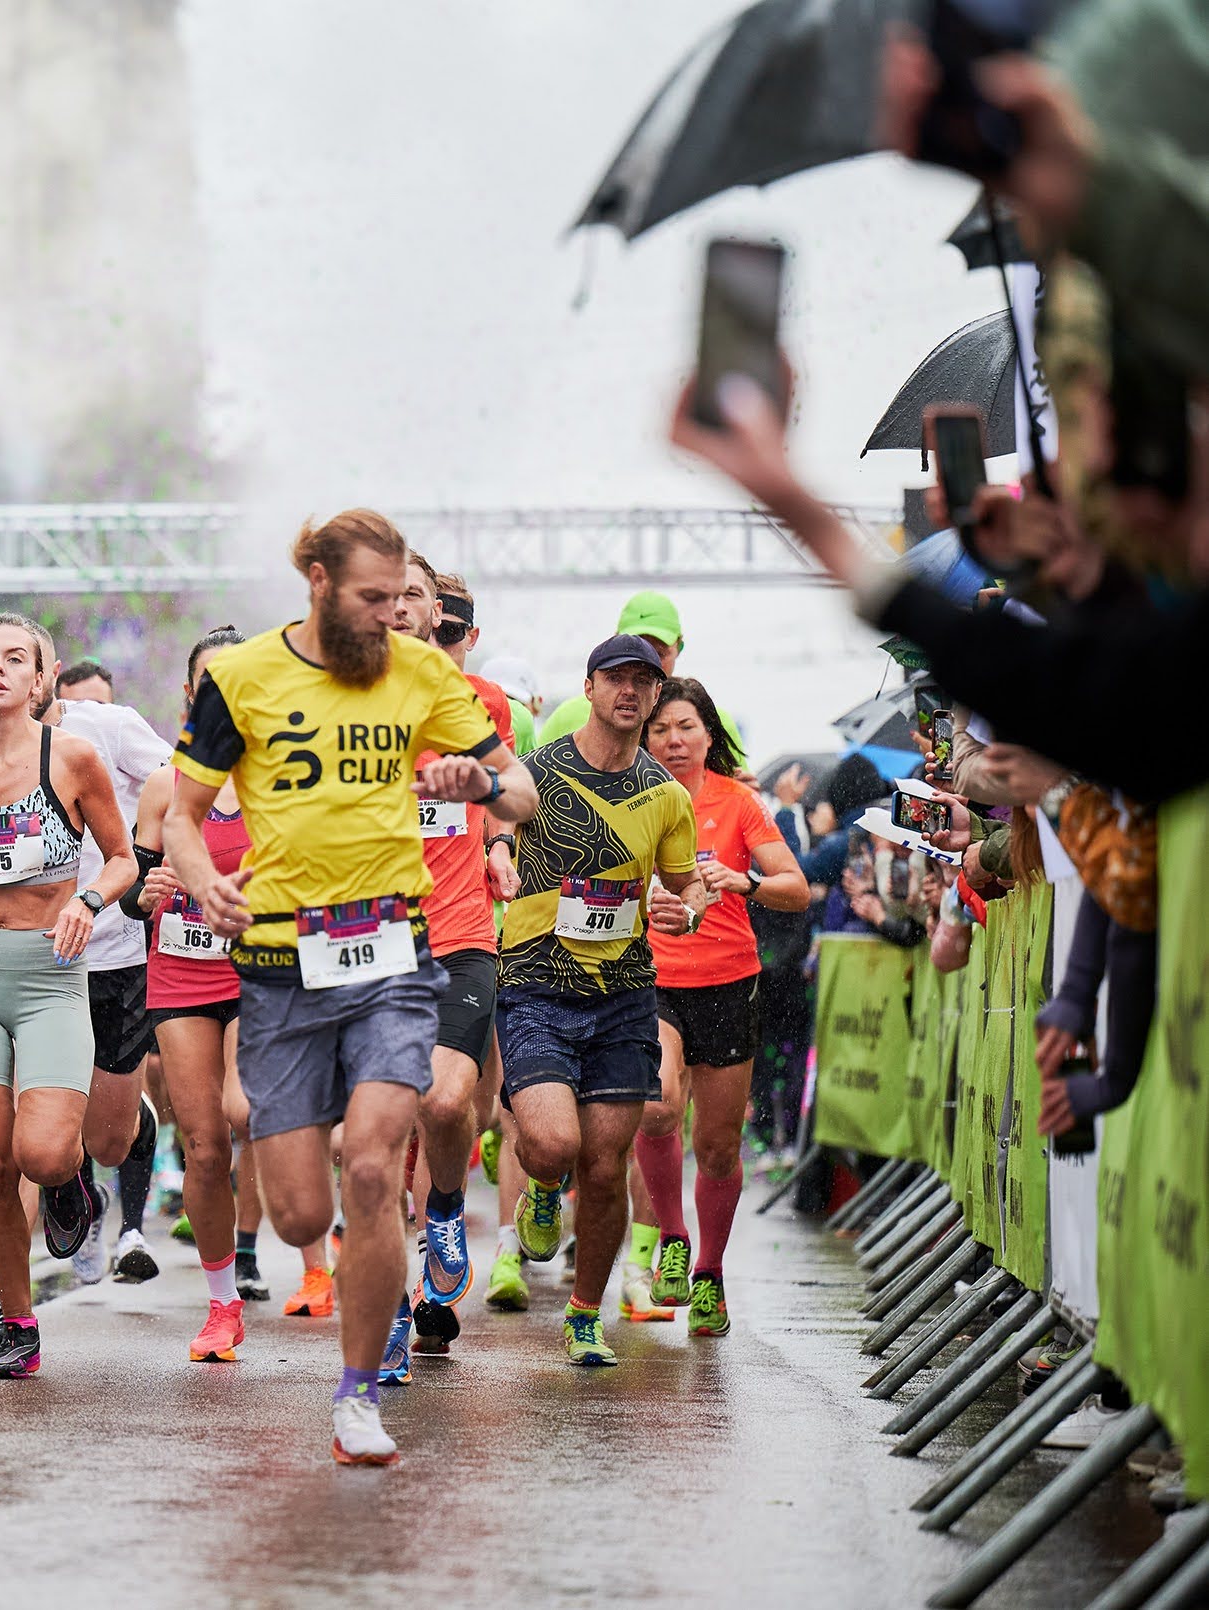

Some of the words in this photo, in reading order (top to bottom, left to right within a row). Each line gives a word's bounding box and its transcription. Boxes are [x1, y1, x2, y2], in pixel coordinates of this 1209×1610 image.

[338, 724, 411, 751] IRON
[627, 793, 654, 812] TERNOPIL
[586, 912, 615, 930] 470
[184, 928, 213, 949] 163
[338, 943, 375, 967] 419
